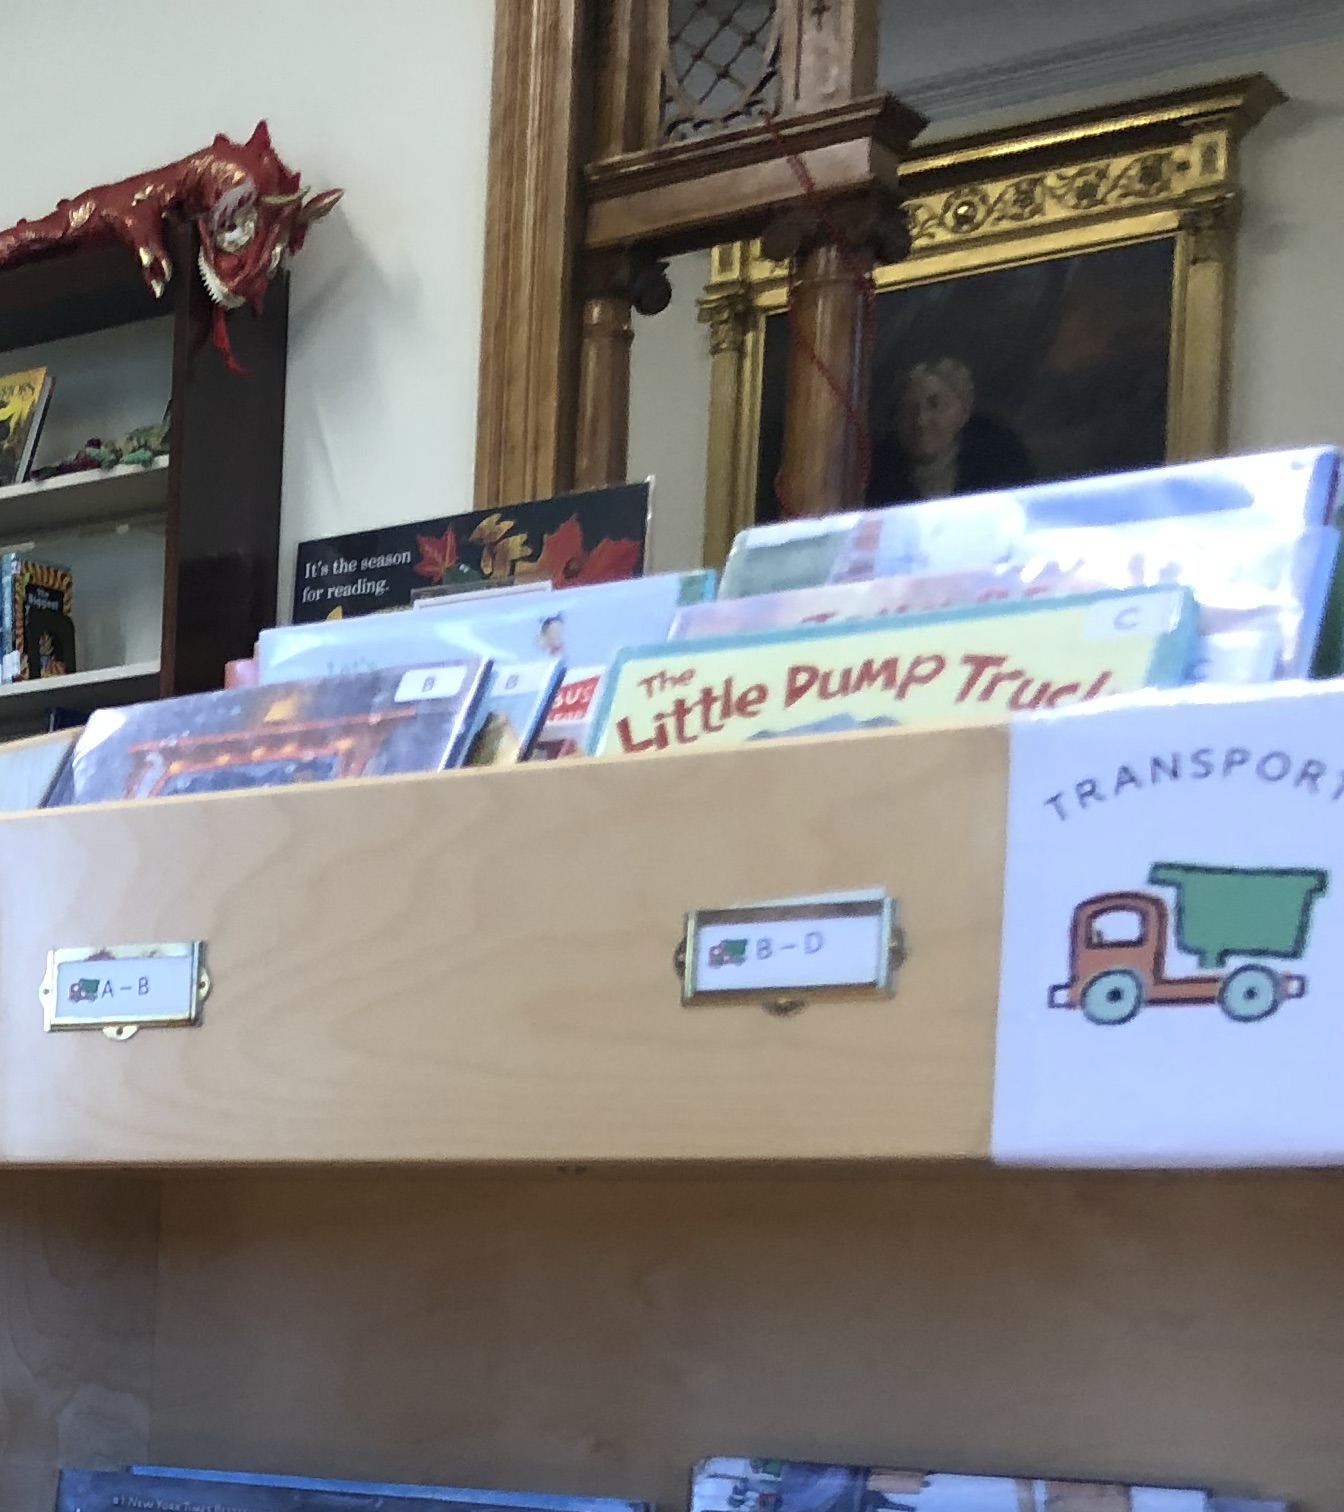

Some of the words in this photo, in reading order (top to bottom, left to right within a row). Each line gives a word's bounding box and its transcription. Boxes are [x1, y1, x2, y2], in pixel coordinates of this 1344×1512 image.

[304, 560, 330, 580] It's
[332, 557, 358, 576] the
[360, 549, 412, 572] season
[301, 585, 325, 604] for
[326, 577, 390, 597] reading.
[637, 667, 697, 700] The
[615, 674, 770, 754] Little
[128, 1496, 153, 1509] NEW
[155, 1499, 181, 1512] YORK
